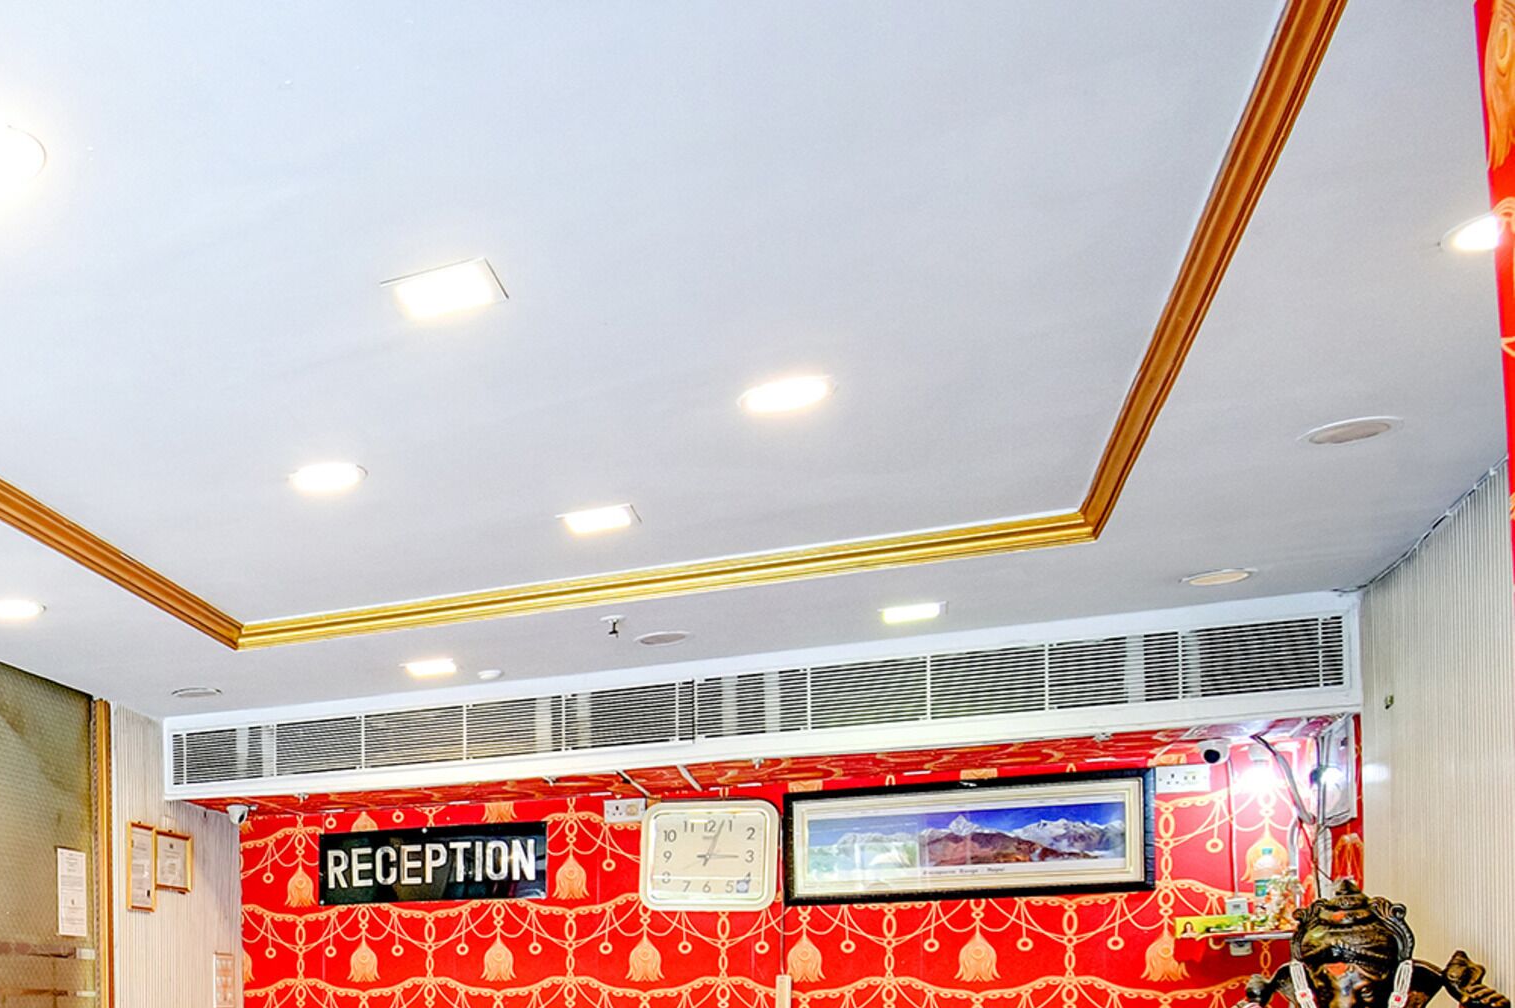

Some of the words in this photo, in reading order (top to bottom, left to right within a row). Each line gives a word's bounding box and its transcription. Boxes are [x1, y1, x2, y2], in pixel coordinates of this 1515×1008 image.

[704, 819, 716, 832] 12
[663, 829, 677, 842] 10
[746, 826, 756, 840] 2
[663, 850, 672, 863] 9
[745, 849, 755, 863] 3
[328, 839, 535, 889] RECEPTION
[683, 880, 691, 893] 7
[702, 881, 711, 893] 6
[725, 880, 734, 893] 5
